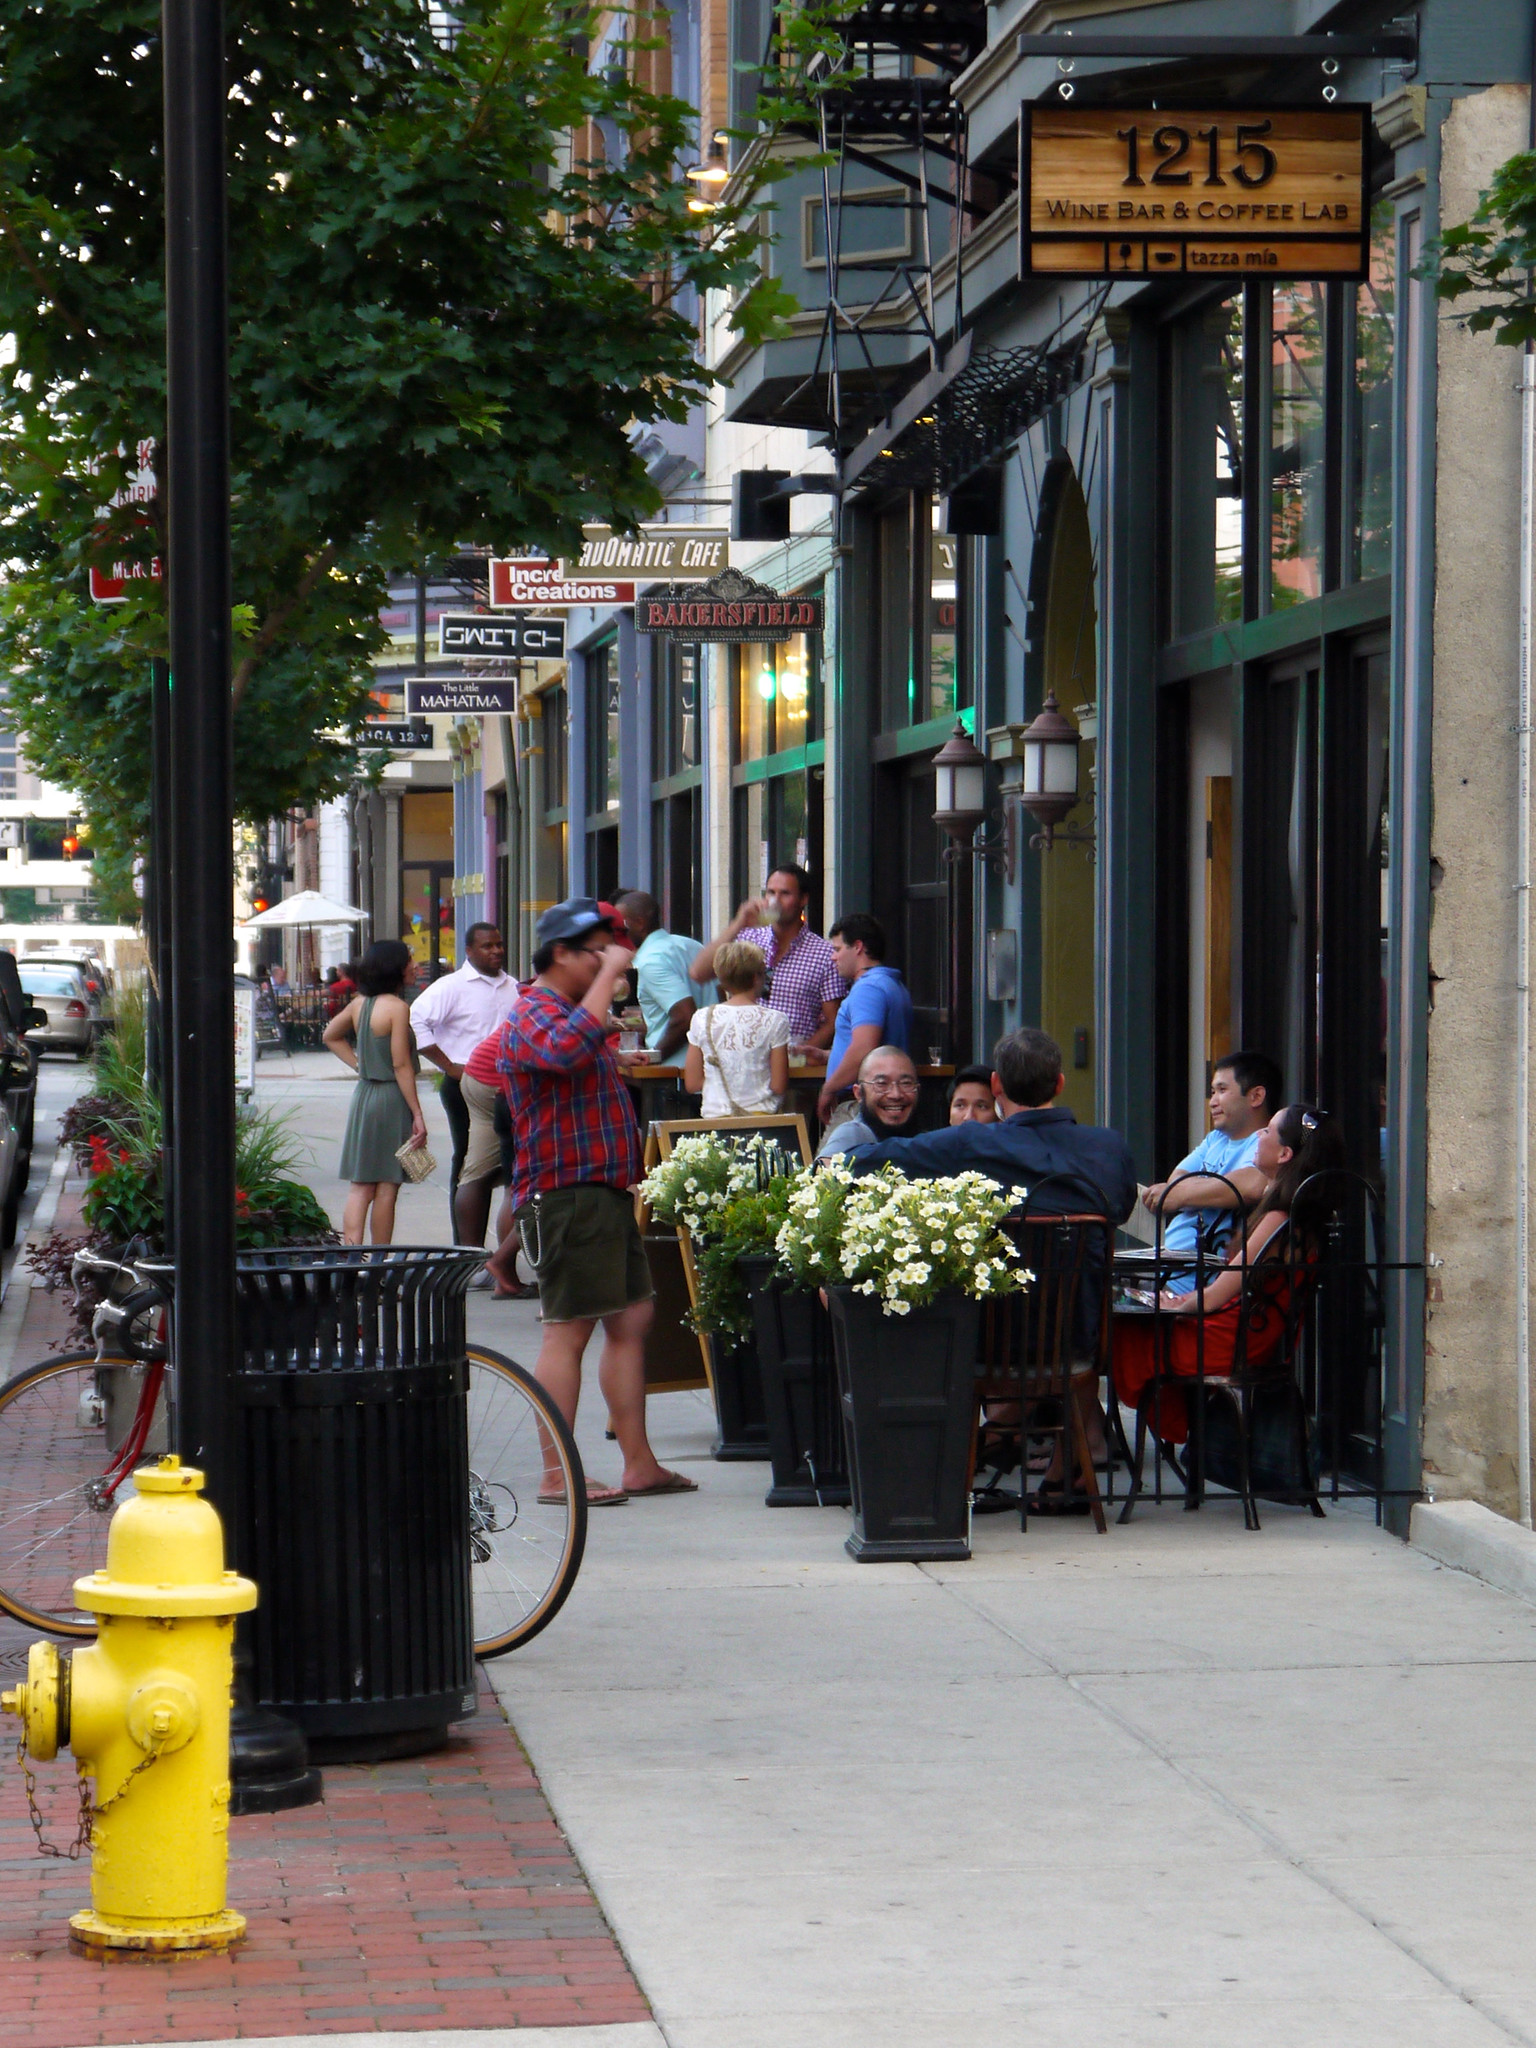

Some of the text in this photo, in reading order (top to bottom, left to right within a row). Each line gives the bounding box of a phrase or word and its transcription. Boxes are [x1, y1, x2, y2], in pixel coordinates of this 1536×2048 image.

[1117, 118, 1278, 188] 1215
[1173, 201, 1190, 219] &
[1190, 250, 1240, 266] tazza
[569, 536, 723, 568] AVOMATIC CAFE
[510, 582, 617, 601] Creations
[647, 602, 815, 627] BAKERSFIELD
[678, 630, 784, 638] TACOS TEQUILA WHISKEY
[442, 682, 480, 693] The Little
[420, 694, 502, 708] MAHATMA
